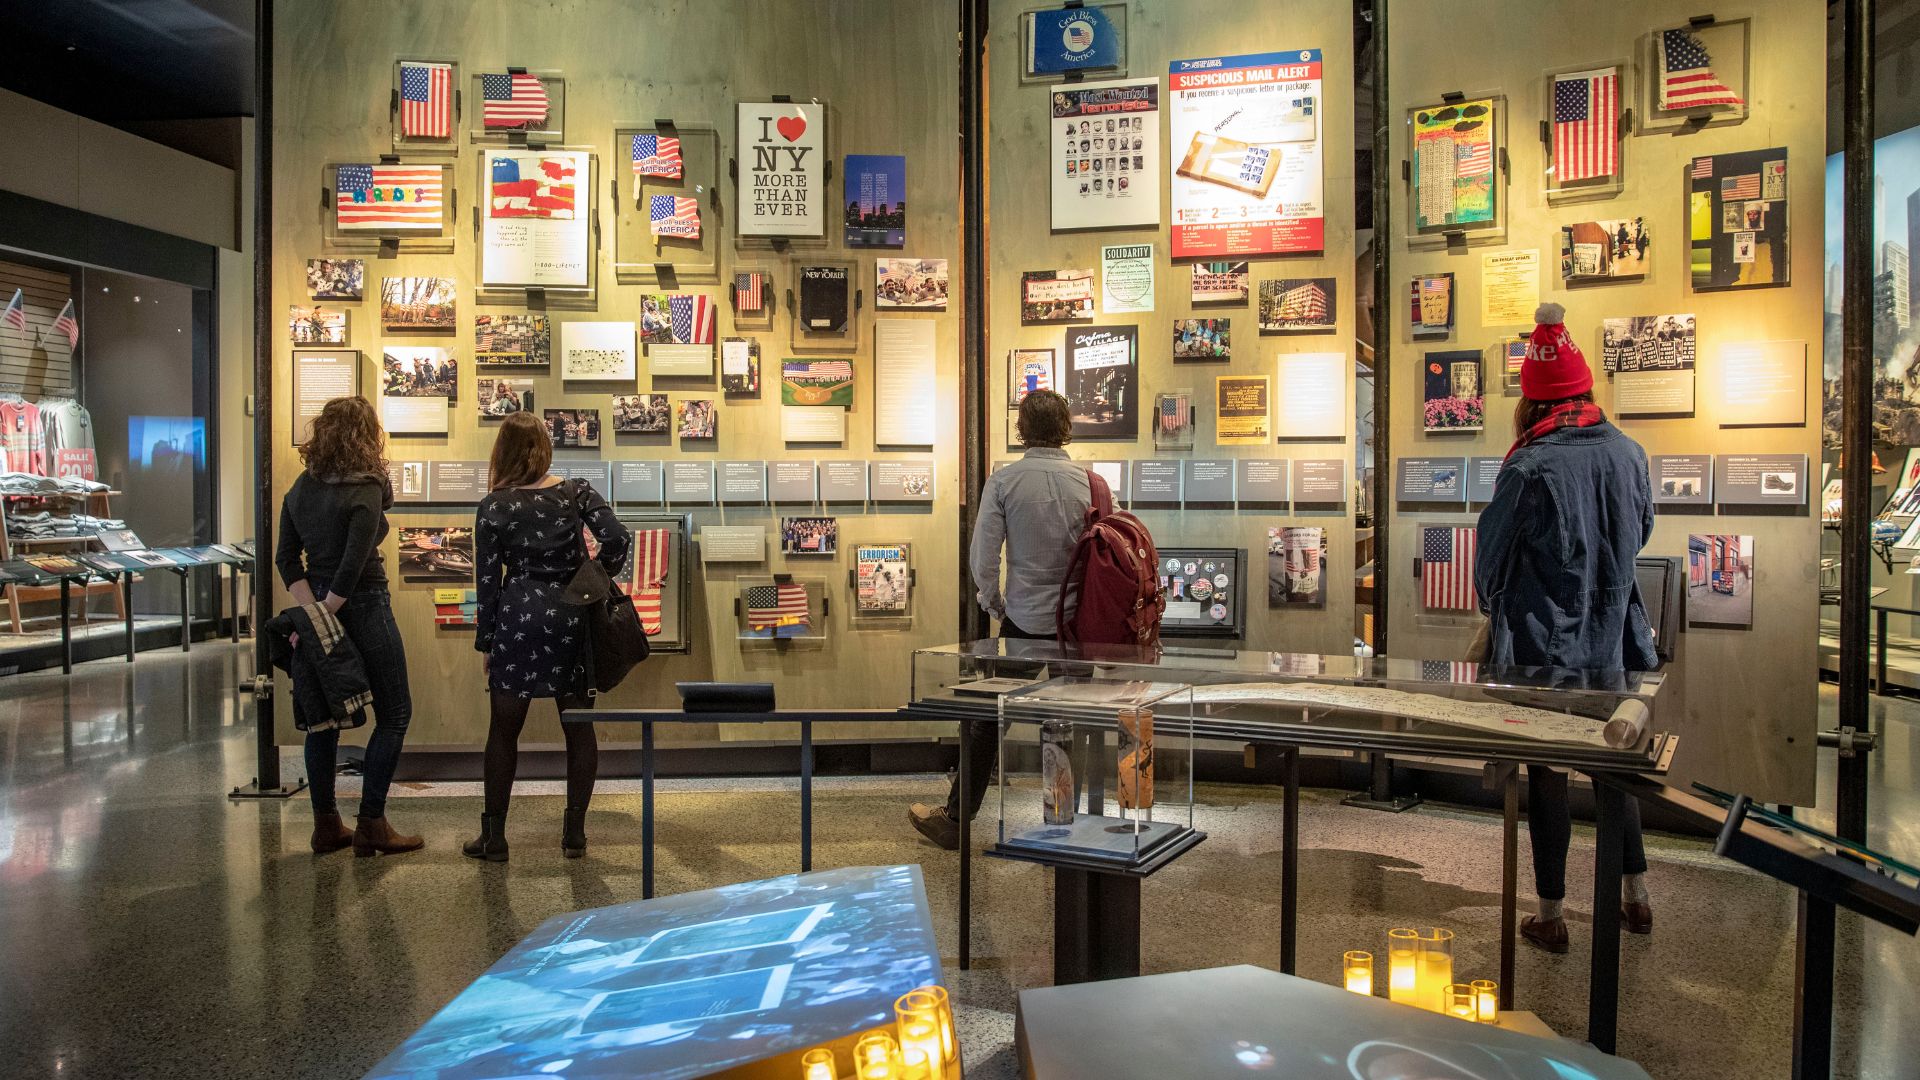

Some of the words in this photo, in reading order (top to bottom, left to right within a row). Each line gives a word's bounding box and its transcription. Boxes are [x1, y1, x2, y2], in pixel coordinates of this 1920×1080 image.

[1058, 11, 1077, 28] God
[1079, 10, 1098, 26] Bless
[1060, 48, 1096, 62] America
[1180, 71, 1244, 87] SUSPICIOUS
[1246, 68, 1274, 82] MAIL
[1277, 65, 1310, 79] ALERT
[1080, 90, 1105, 103] Most
[1107, 86, 1149, 102] Wanted
[1180, 90, 1185, 99] If
[1187, 91, 1197, 100] you
[1198, 88, 1219, 98] receive
[1227, 85, 1258, 97] suspicious
[1259, 84, 1275, 93] letter
[1285, 82, 1312, 93] package:
[1080, 100, 1149, 114] Terrorists
[758, 116, 773, 142] I
[752, 145, 813, 172] NY
[639, 166, 679, 174] AMERICA
[1768, 167, 1775, 175] I
[753, 174, 807, 187] MORE
[753, 188, 808, 202] THAN
[753, 203, 808, 216] EVER
[1177, 208, 1183, 220] 1
[1211, 207, 1219, 219] 2
[1240, 205, 1248, 217] 3
[1275, 203, 1283, 215] 4
[657, 226, 697, 234] AMERICA
[1106, 246, 1149, 259] SOLIDARITY
[805, 271, 820, 279] NEW
[820, 271, 846, 279] YORKER
[1085, 334, 1126, 347] VILLAGE
[1526, 339, 1558, 362] ke
[63, 453, 89, 462] SALE
[859, 549, 900, 559] TERRORISM
